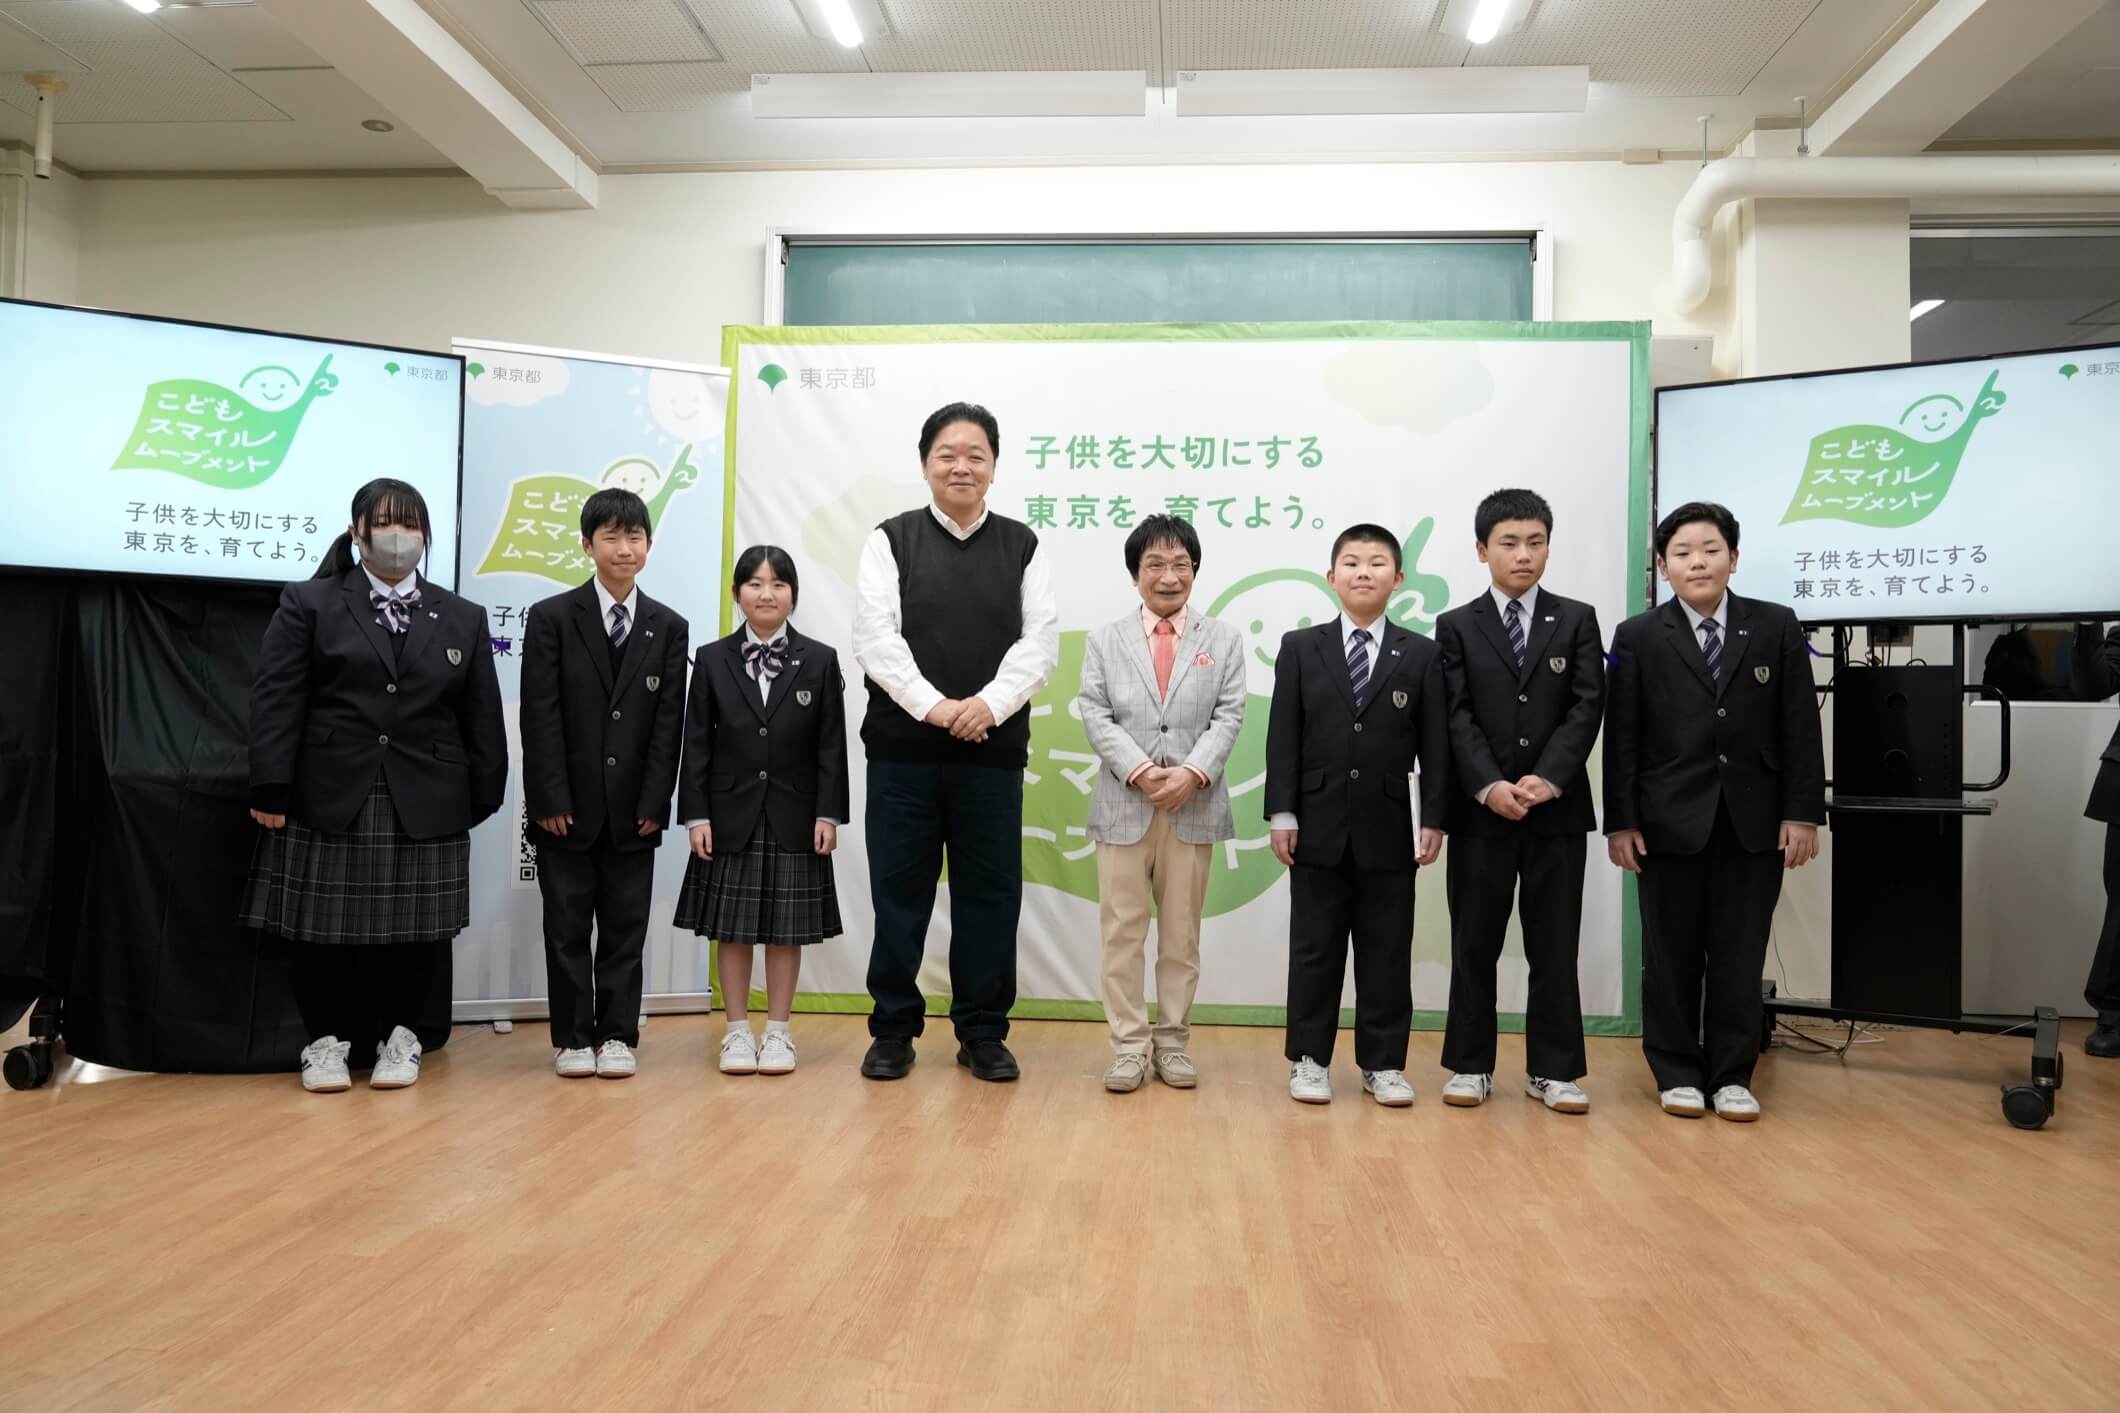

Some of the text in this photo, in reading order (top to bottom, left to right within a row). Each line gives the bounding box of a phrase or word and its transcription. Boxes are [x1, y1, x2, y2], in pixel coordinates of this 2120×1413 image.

[406, 365, 448, 381] 東京都
[492, 366, 541, 385] 東京都
[799, 367, 877, 390] 東京都
[157, 393, 243, 422] こども
[146, 417, 277, 448] スマイル
[134, 442, 271, 473] ムーブメント
[1025, 435, 1324, 470] 子供を大切にする
[1820, 438, 1905, 462] こども
[1811, 461, 1940, 487] スマイル
[1024, 494, 1325, 530] 東京を育てよう。
[1801, 491, 1934, 512] ムーブメント
[125, 501, 318, 534] 子供を大切にする
[123, 530, 319, 564] 東京を、育てよう。
[1793, 544, 1988, 572] 子供を大切にする
[1793, 573, 1990, 599] 東京を、育てよう。
